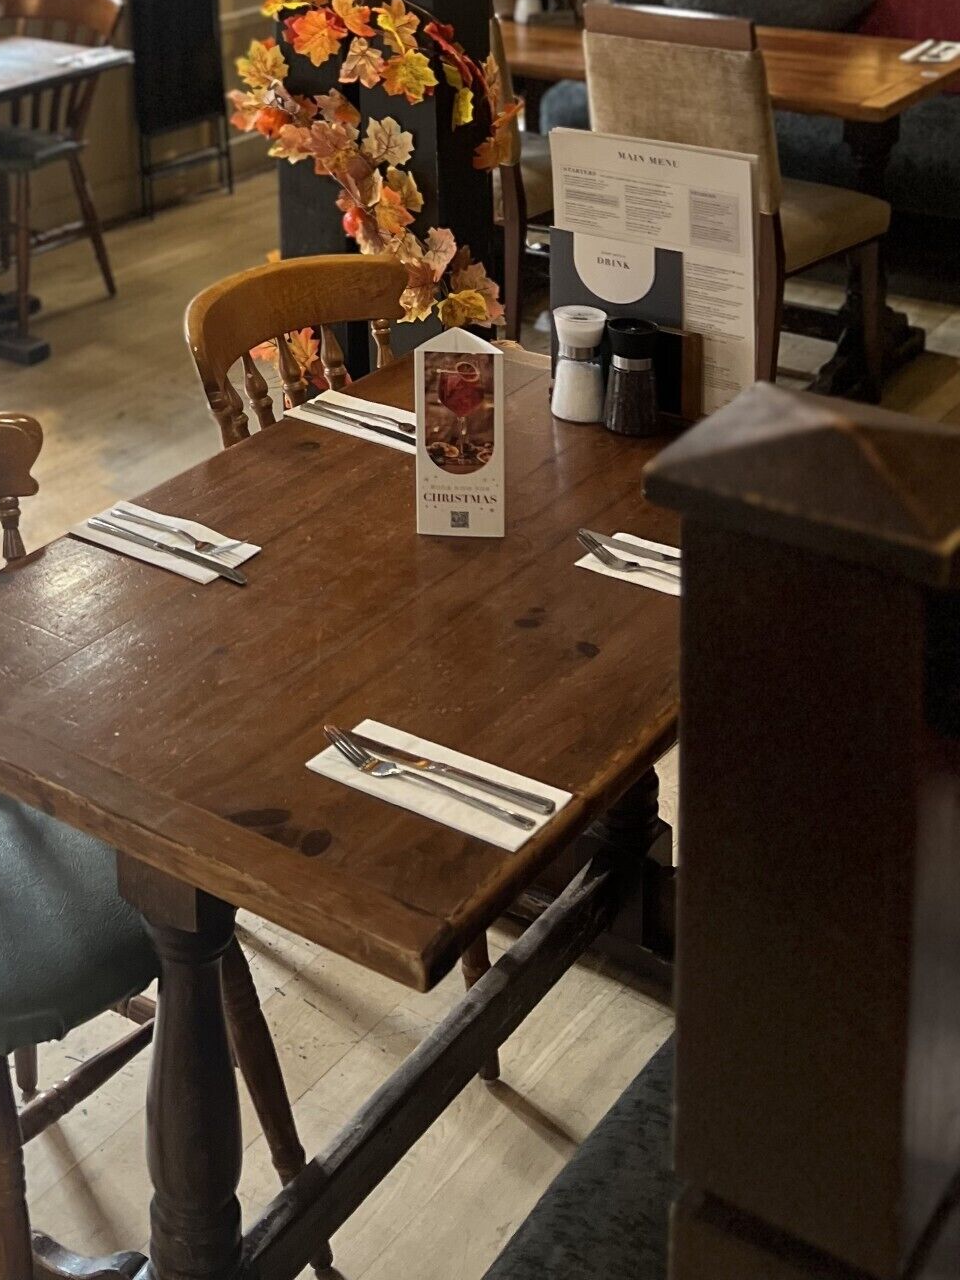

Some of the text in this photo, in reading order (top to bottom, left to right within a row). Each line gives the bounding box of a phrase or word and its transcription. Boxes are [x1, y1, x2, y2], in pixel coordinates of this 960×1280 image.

[617, 151, 680, 168] MAIN MENU
[596, 256, 630, 270] DRINK
[423, 492, 497, 504] CHRISTMAS
